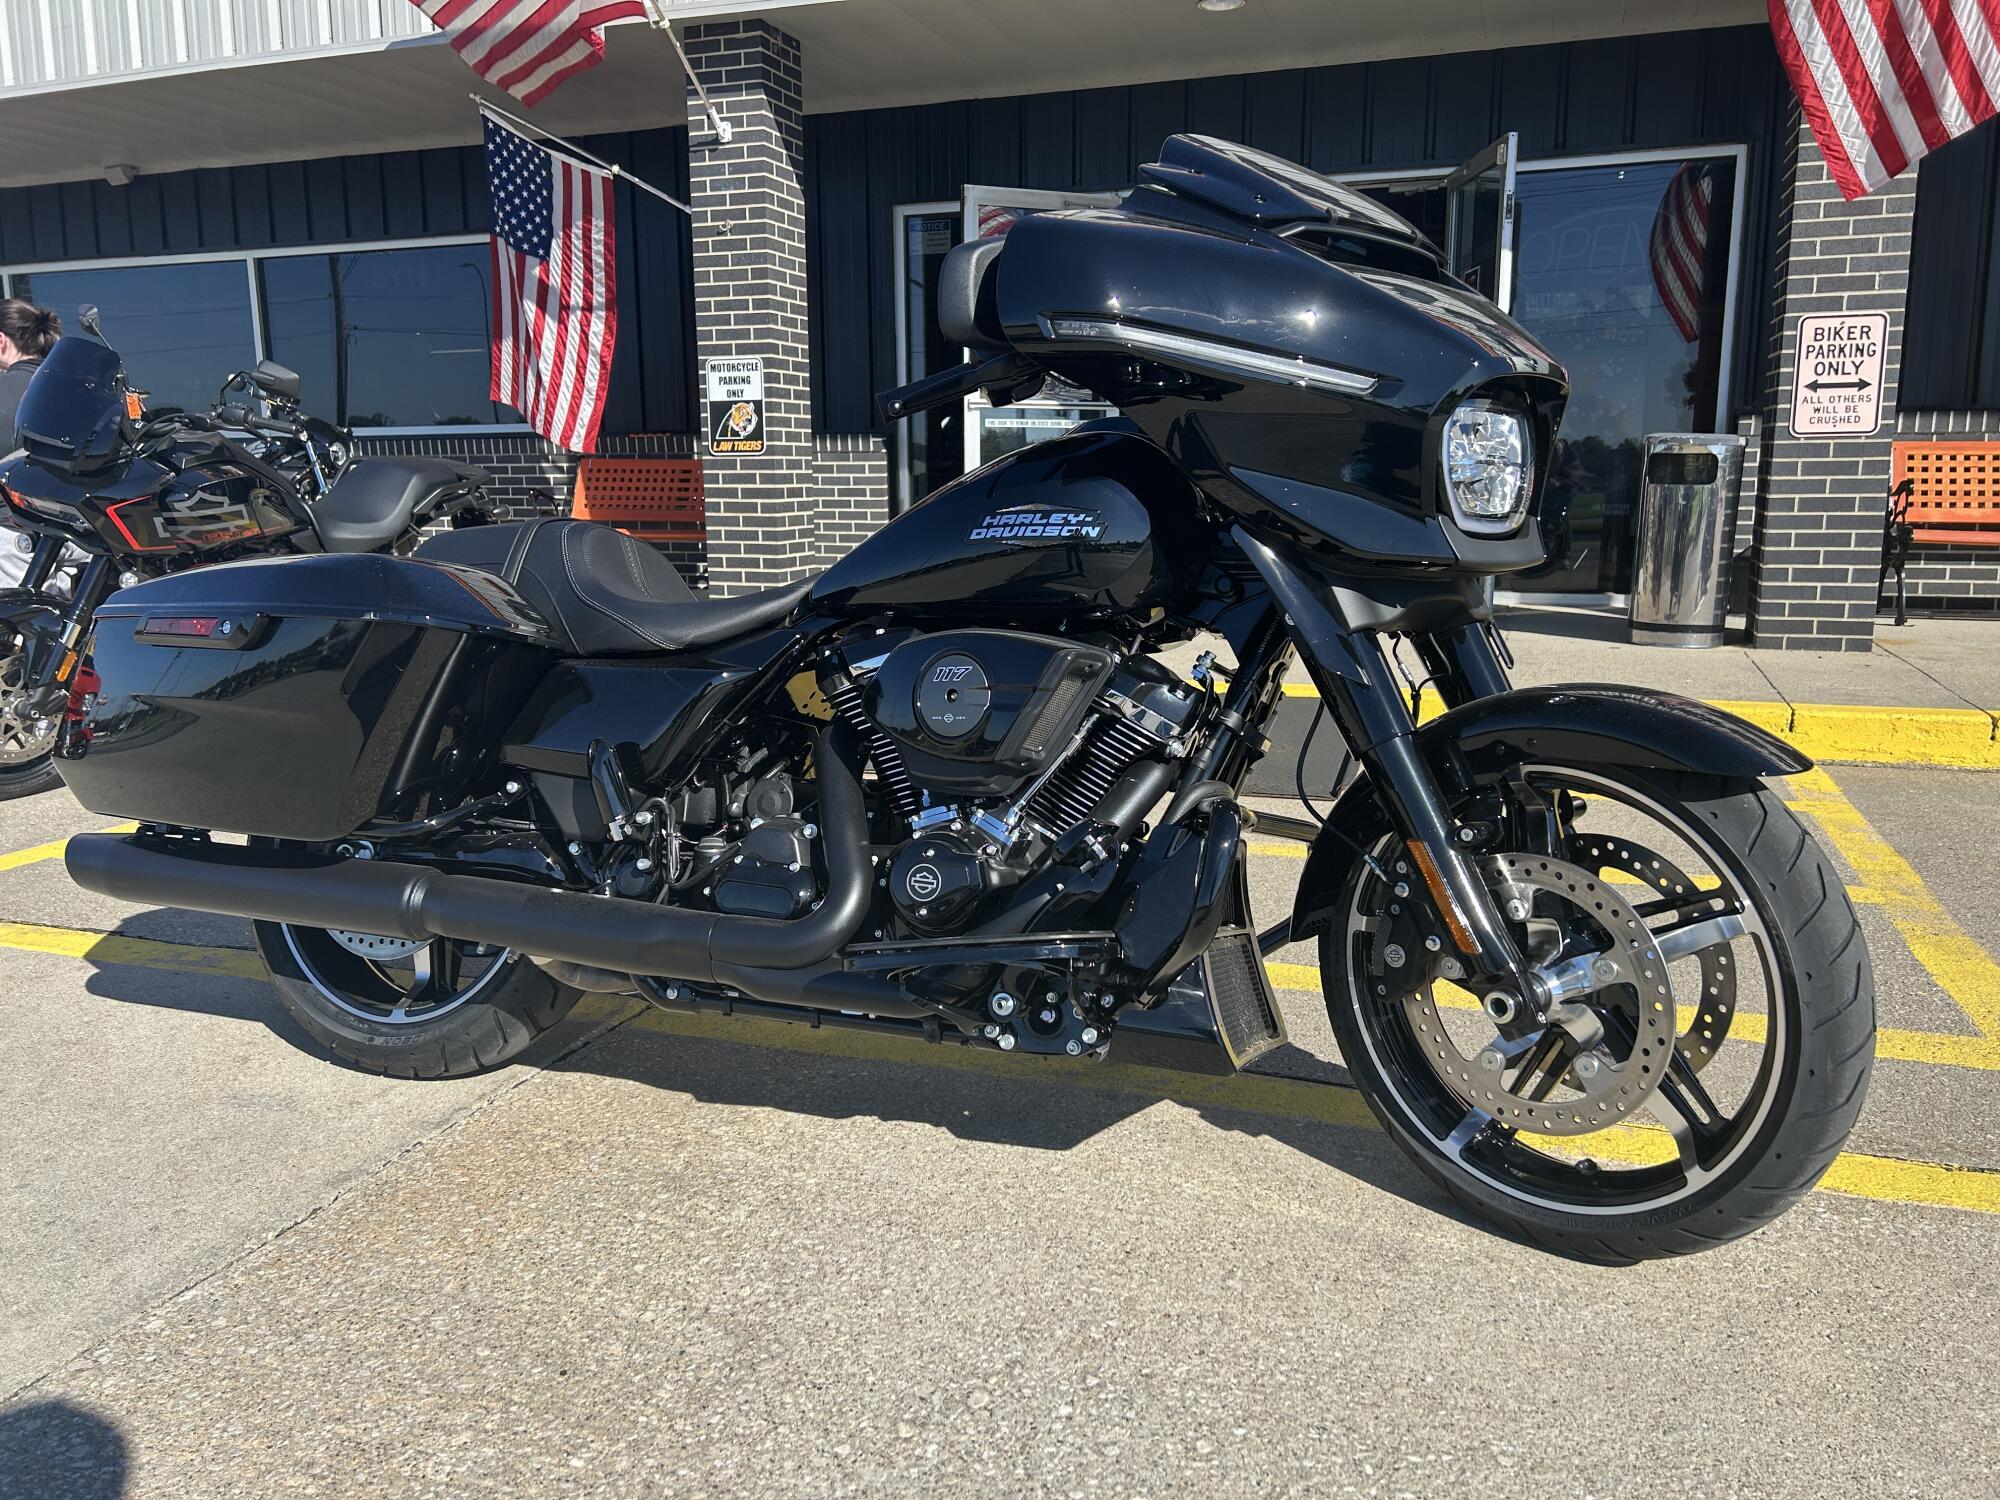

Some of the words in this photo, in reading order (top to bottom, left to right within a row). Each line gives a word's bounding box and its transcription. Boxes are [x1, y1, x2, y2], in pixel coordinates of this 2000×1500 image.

[1518, 221, 1651, 280] OPEN
[1814, 325, 1872, 342] BIKER
[1805, 342, 1877, 360] PARKING
[710, 362, 759, 373] MOTORCYCLE
[1814, 360, 1864, 376] ONLY
[718, 375, 751, 386] PARKING
[726, 388, 745, 399] ONLY
[1802, 395, 1823, 405] ALL
[1828, 394, 1872, 404] OTHERS
[1813, 405, 1838, 414] WILL
[1845, 405, 1859, 413] BE
[1809, 415, 1861, 425] CRUSHED
[713, 440, 734, 452] LAW
[734, 440, 762, 451] TIGERS
[982, 513, 1093, 527] HARLEY-
[969, 525, 1101, 540] DAVIDSON
[933, 666, 973, 682] 117
